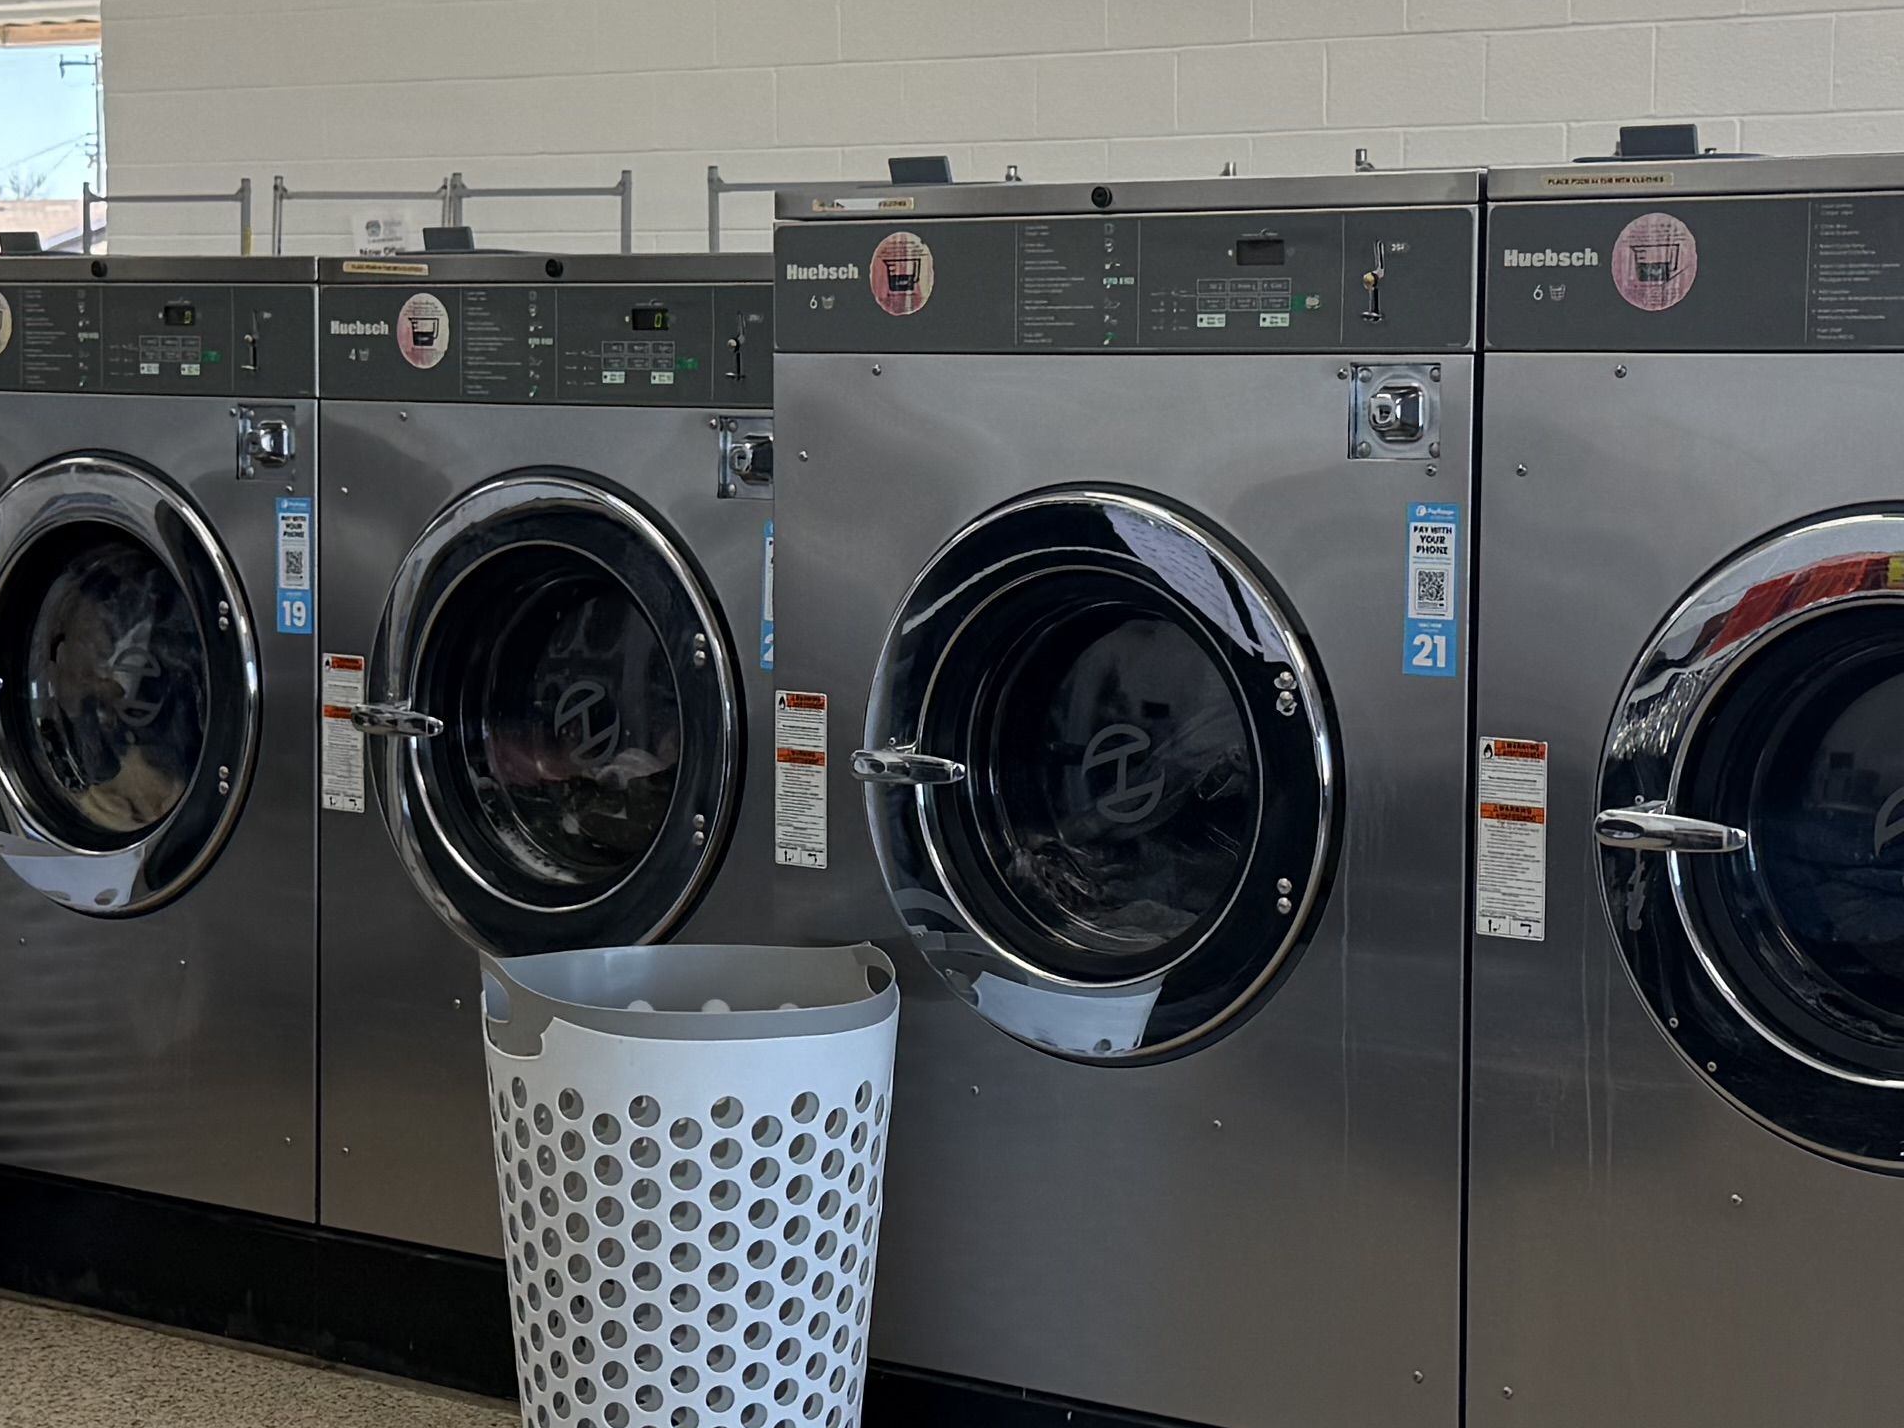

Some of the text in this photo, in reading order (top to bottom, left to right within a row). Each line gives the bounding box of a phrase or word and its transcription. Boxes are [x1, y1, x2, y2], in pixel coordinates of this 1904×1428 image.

[1503, 248, 1599, 268] Huebsch
[786, 264, 859, 280] Huebsch
[1533, 285, 1544, 301] 6
[810, 296, 818, 309] 6
[330, 320, 389, 337] Huebsch
[349, 348, 356, 361] 4
[1420, 535, 1446, 545] YOUR
[282, 600, 307, 629] 19
[1413, 634, 1446, 668] 21
